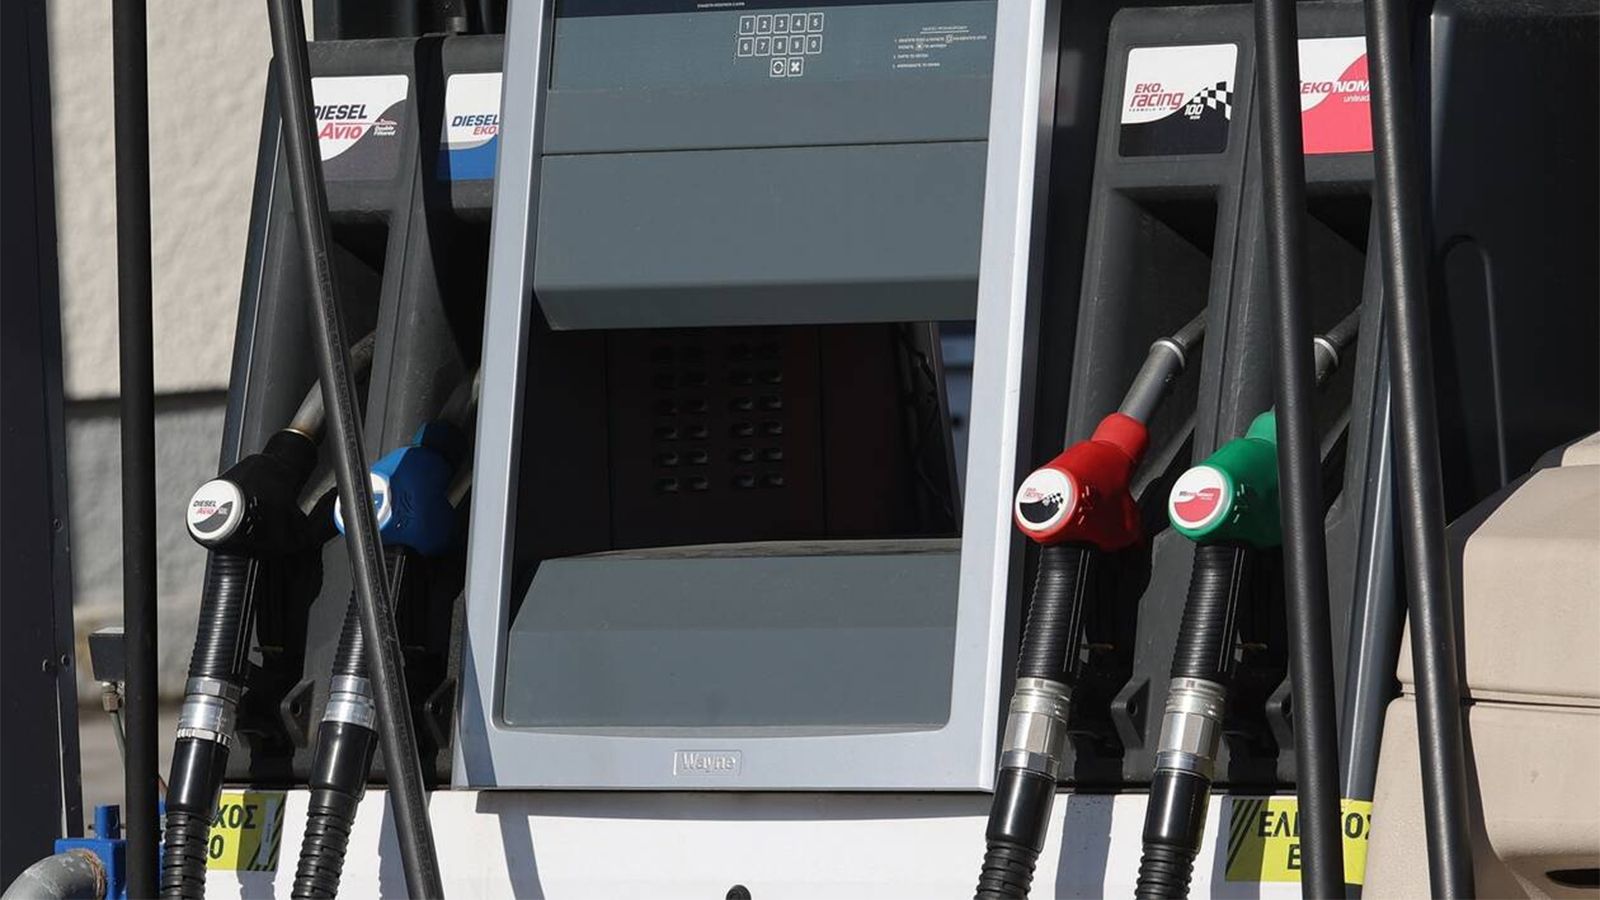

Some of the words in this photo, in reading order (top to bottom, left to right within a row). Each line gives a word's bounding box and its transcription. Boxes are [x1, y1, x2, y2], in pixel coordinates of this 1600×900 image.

[1301, 80, 1370, 94] EKONOM
[1130, 92, 1184, 110] racing
[1343, 94, 1370, 102] unlead
[314, 104, 368, 121] DIESEL
[1184, 104, 1204, 116] 100
[452, 114, 499, 127] DIESEL
[473, 126, 499, 136] EKO
[193, 499, 216, 507] DIESEL
[681, 752, 736, 773] Wayne
